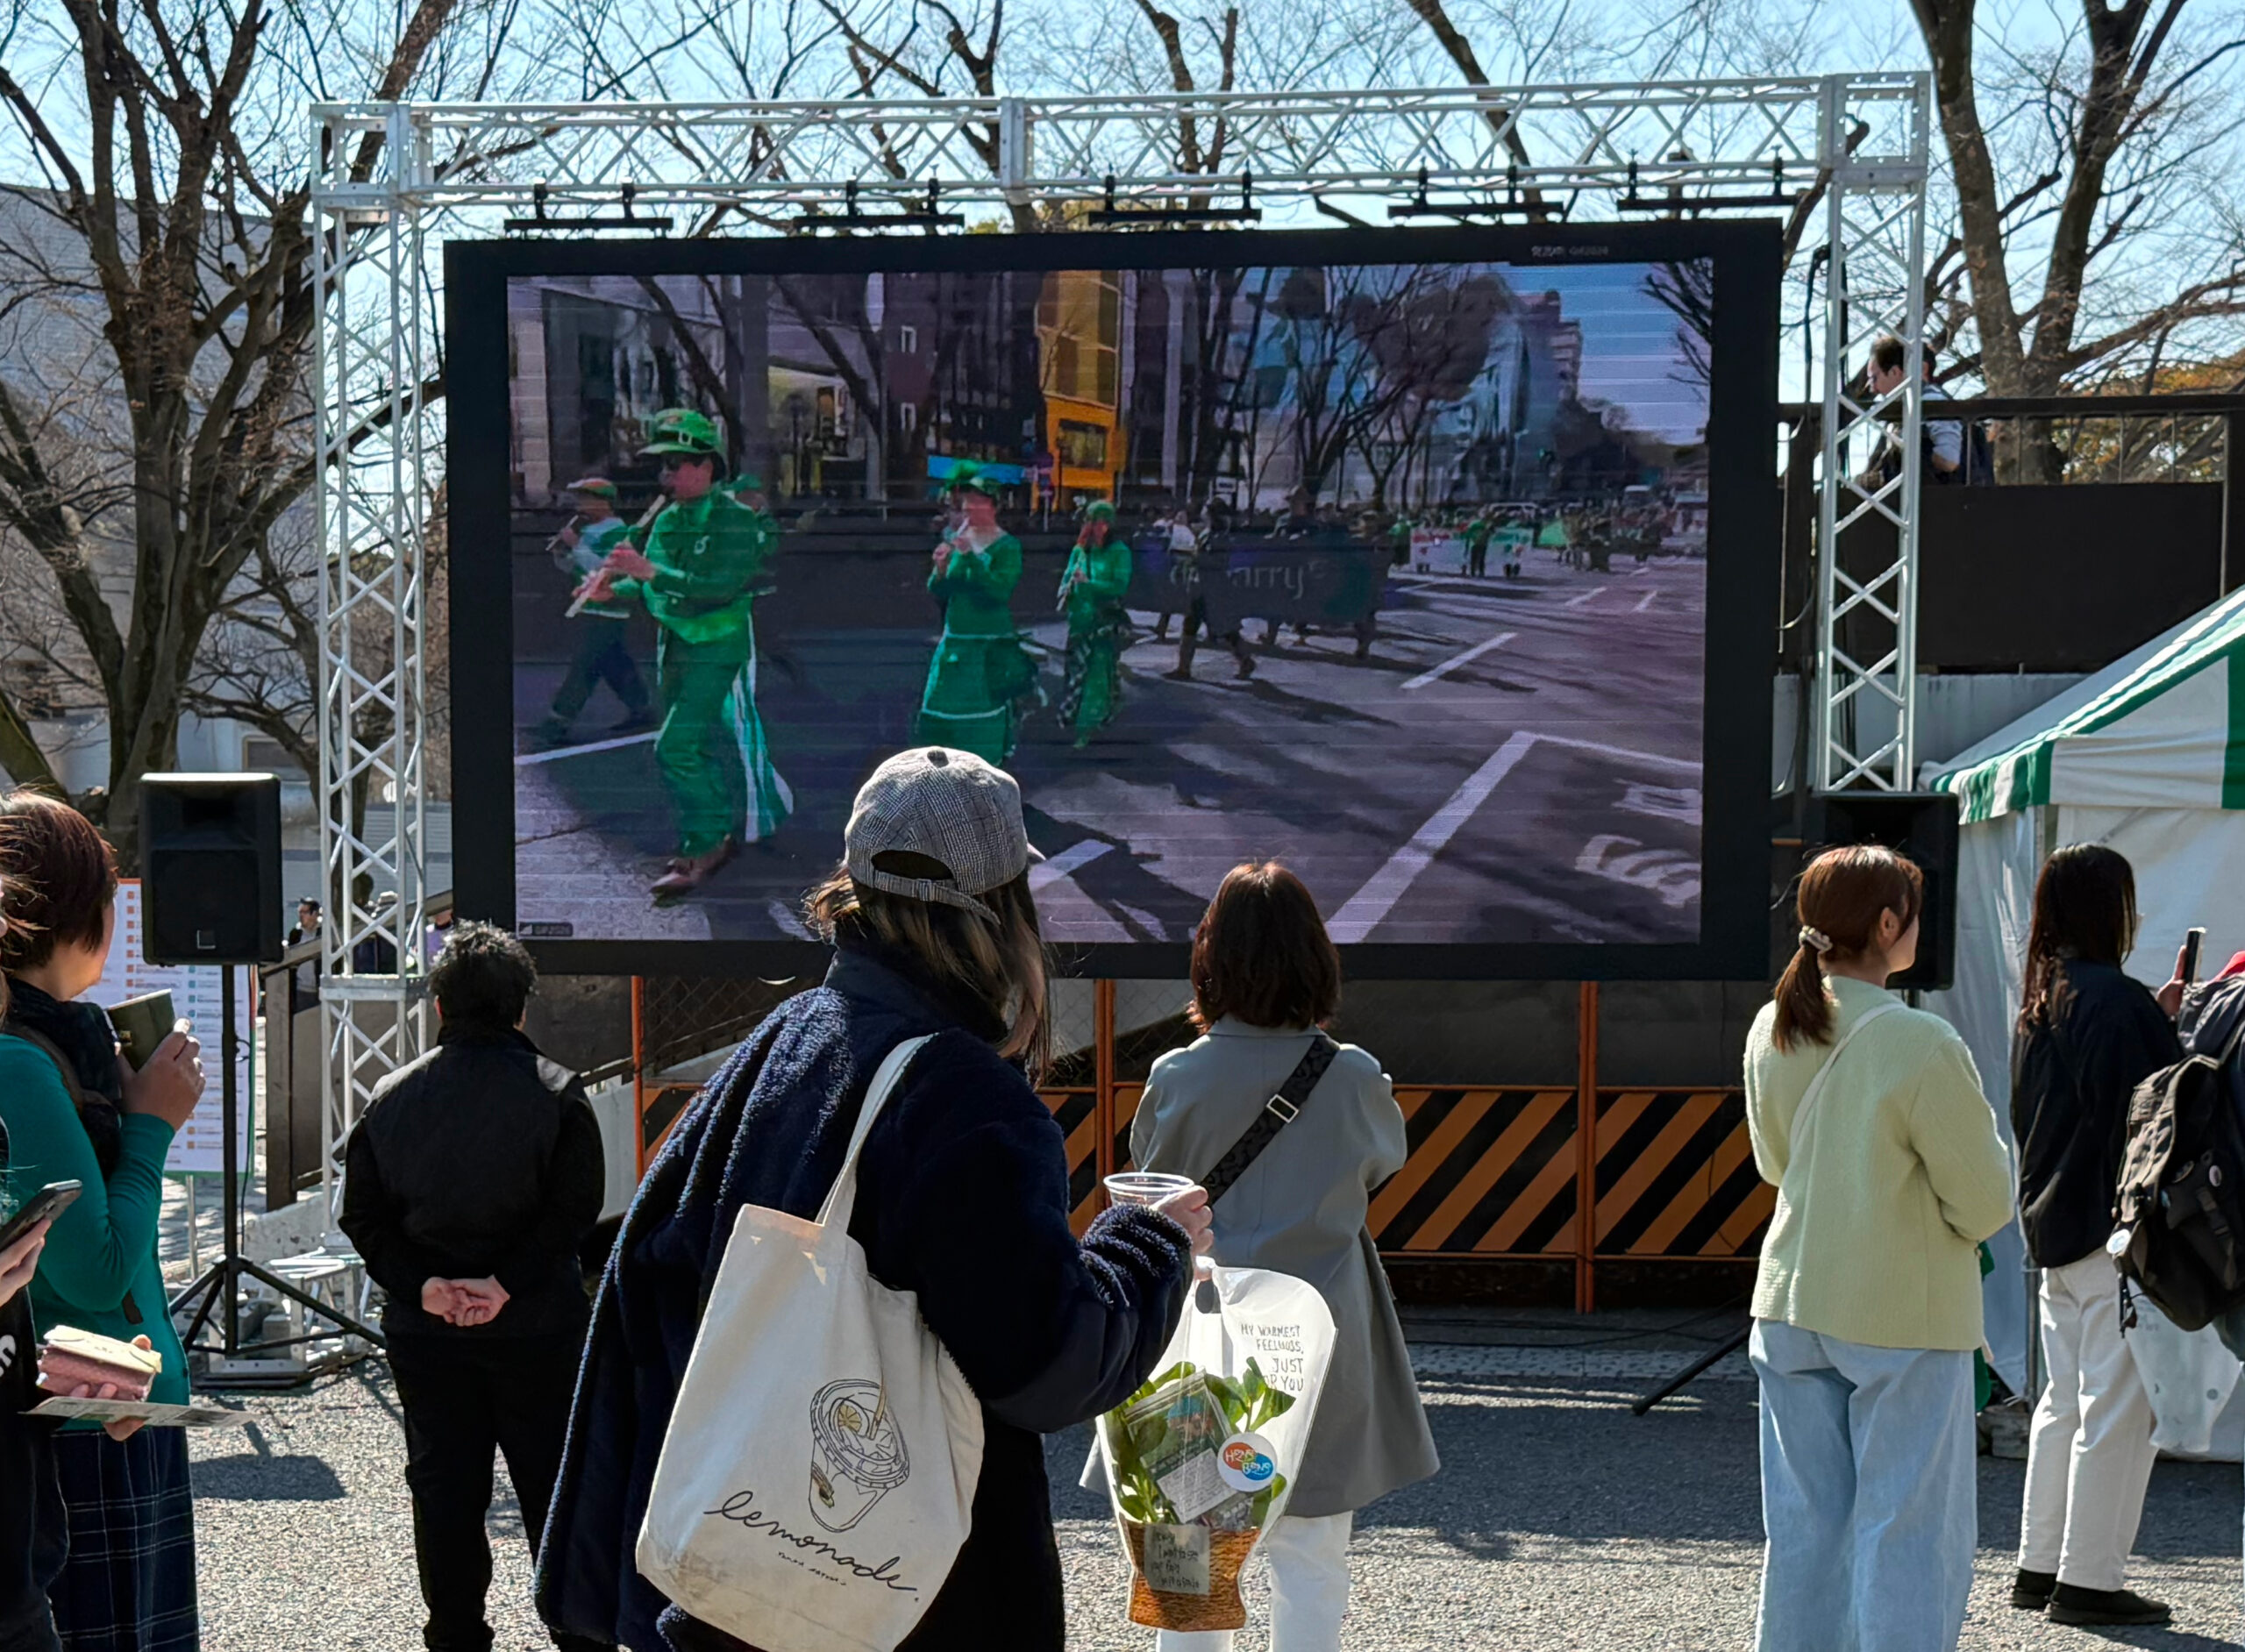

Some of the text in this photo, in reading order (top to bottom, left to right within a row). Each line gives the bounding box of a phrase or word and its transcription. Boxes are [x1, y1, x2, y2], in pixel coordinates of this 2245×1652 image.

[1241, 1324, 1301, 1337] MY WARMEST
[1272, 1358, 1303, 1373] JUST
[1281, 1377, 1304, 1392] YOU
